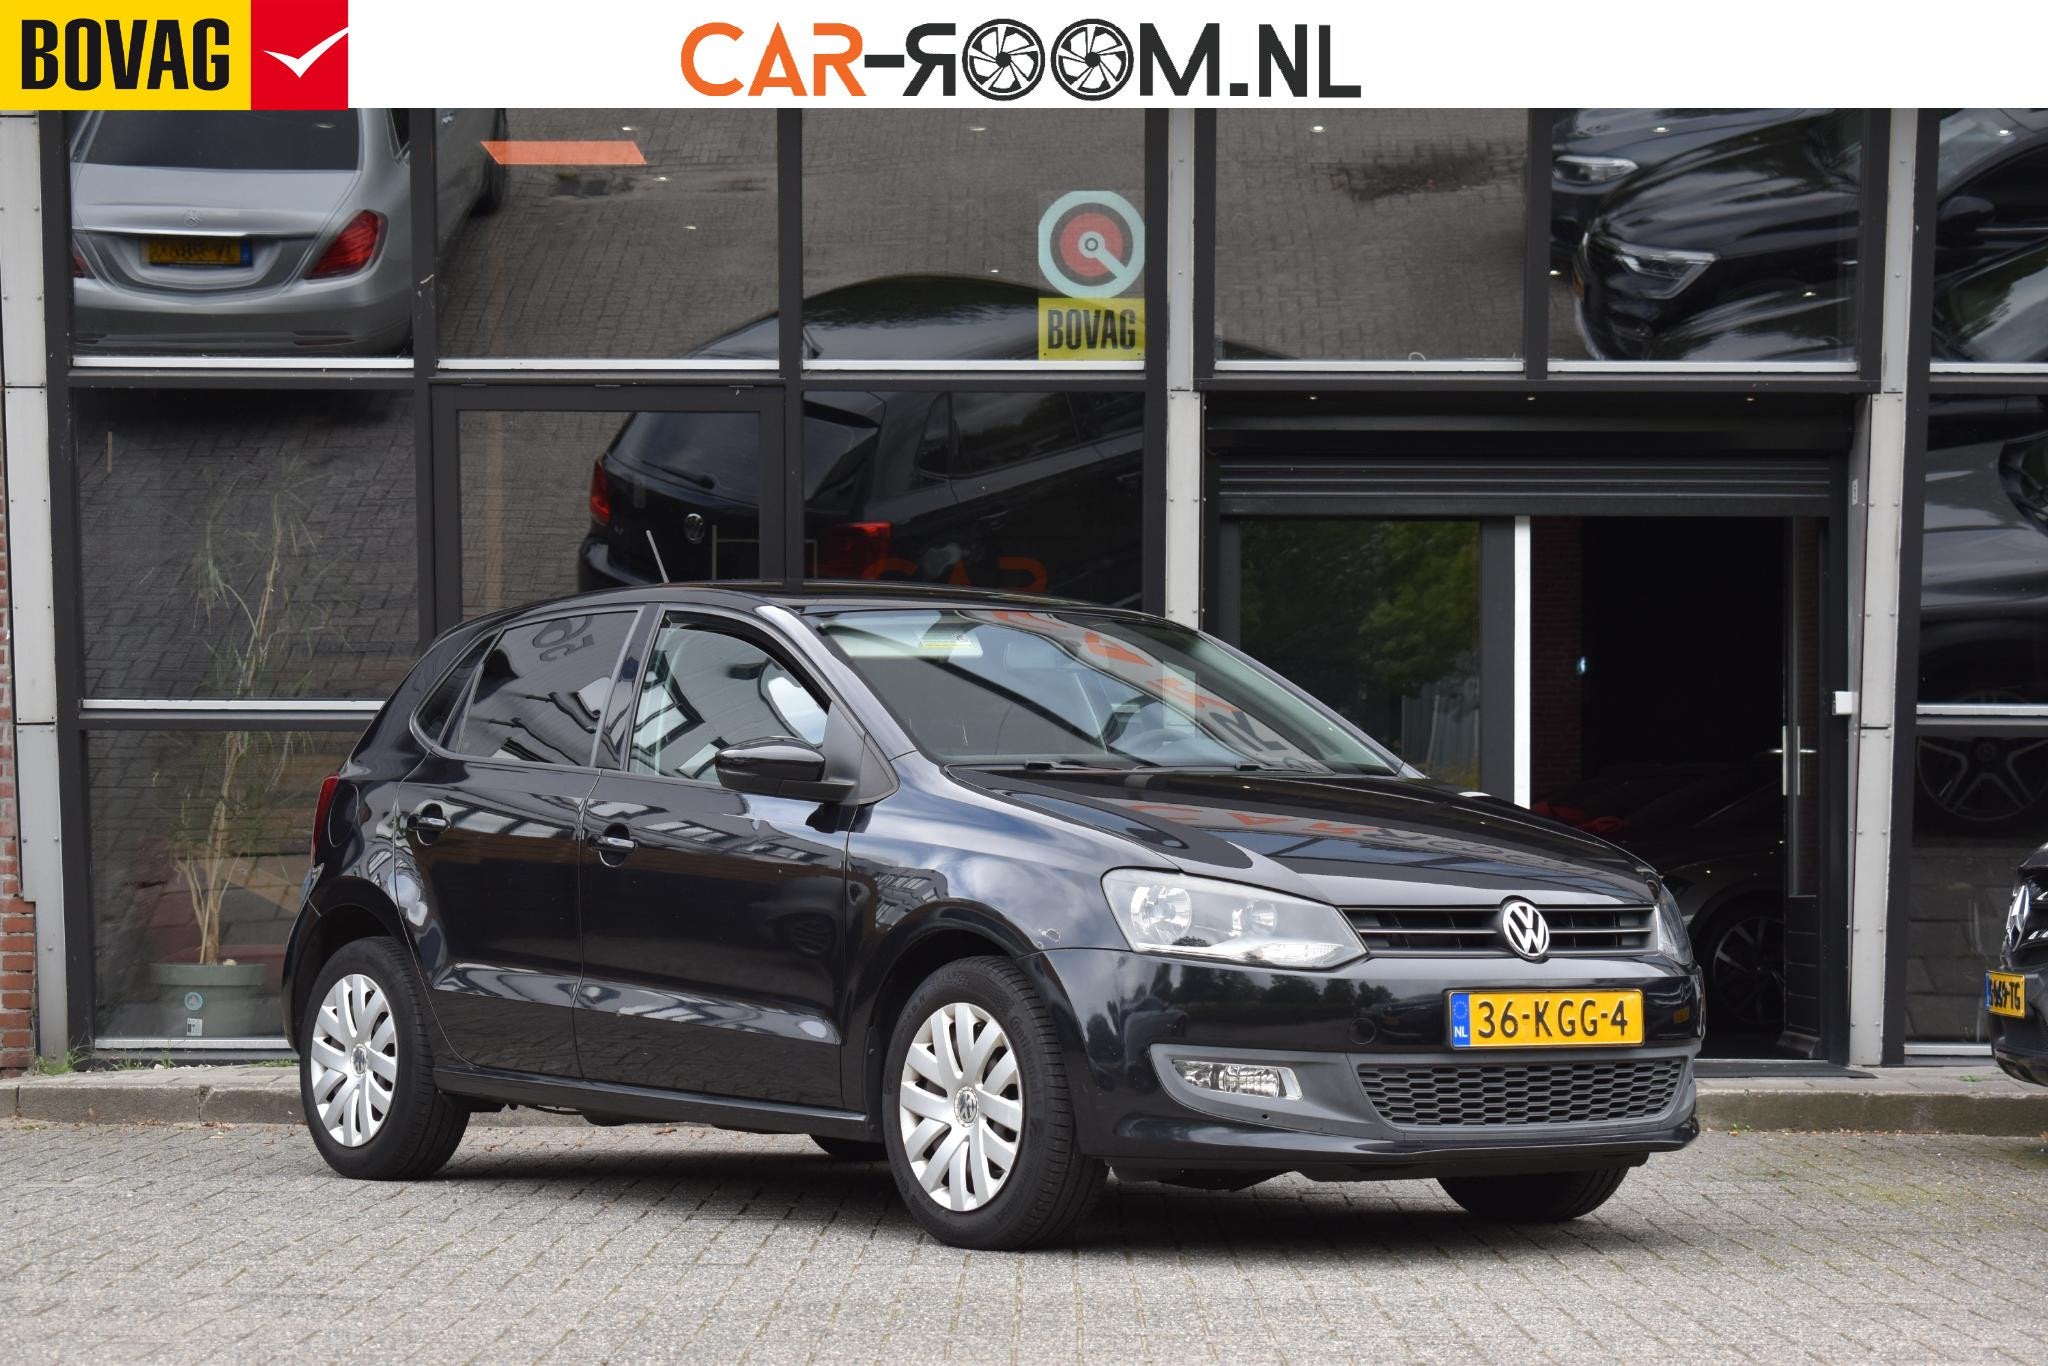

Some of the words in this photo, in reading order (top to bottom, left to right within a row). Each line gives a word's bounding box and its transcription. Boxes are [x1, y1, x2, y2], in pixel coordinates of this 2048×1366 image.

[1047, 308, 1136, 350] BOVAG
[1454, 1026, 1468, 1038] NL
[1478, 999, 1628, 1038] 36-KGG-4
